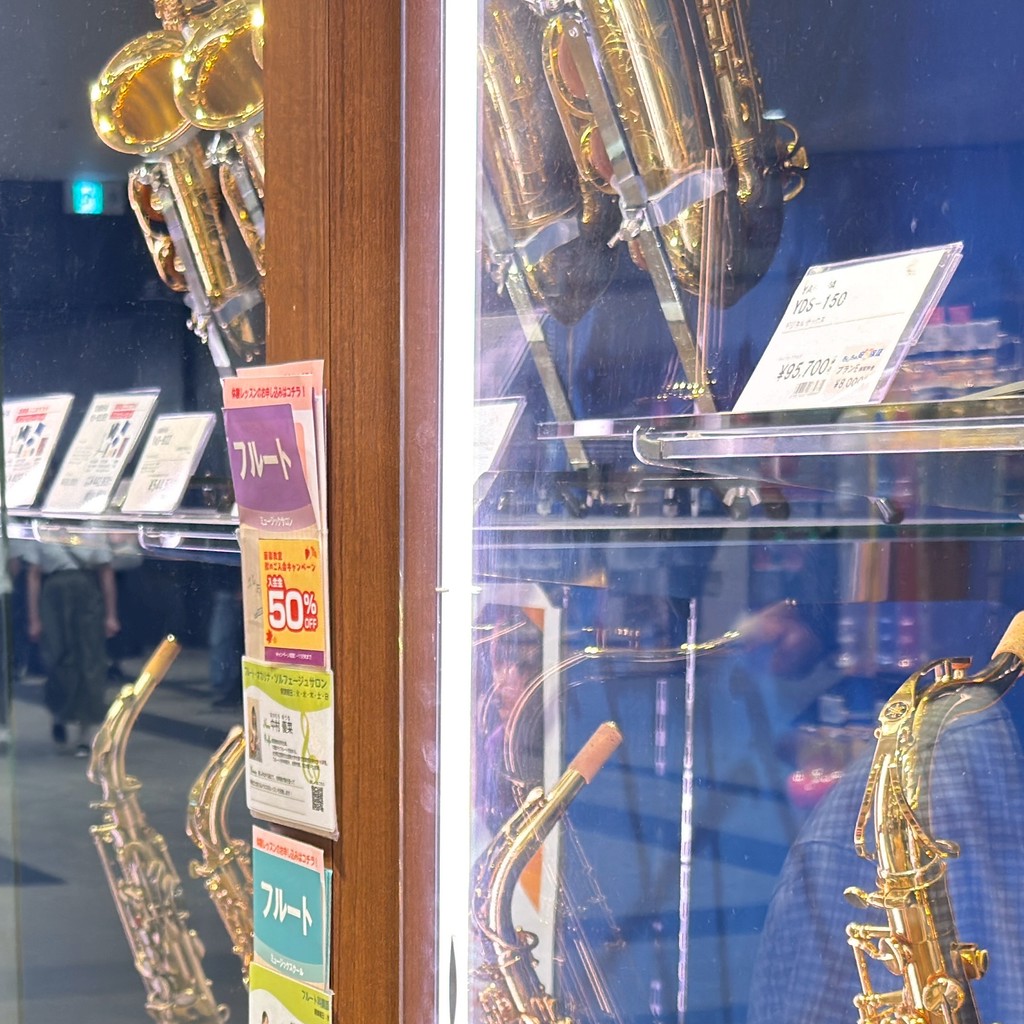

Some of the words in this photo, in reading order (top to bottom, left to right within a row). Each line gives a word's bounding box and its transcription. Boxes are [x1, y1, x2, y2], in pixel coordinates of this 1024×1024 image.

[793, 291, 848, 315] YDS-150
[233, 438, 293, 481] フルート
[269, 589, 318, 631] 50%
[304, 617, 318, 630] OFF
[260, 881, 313, 936] フルート
